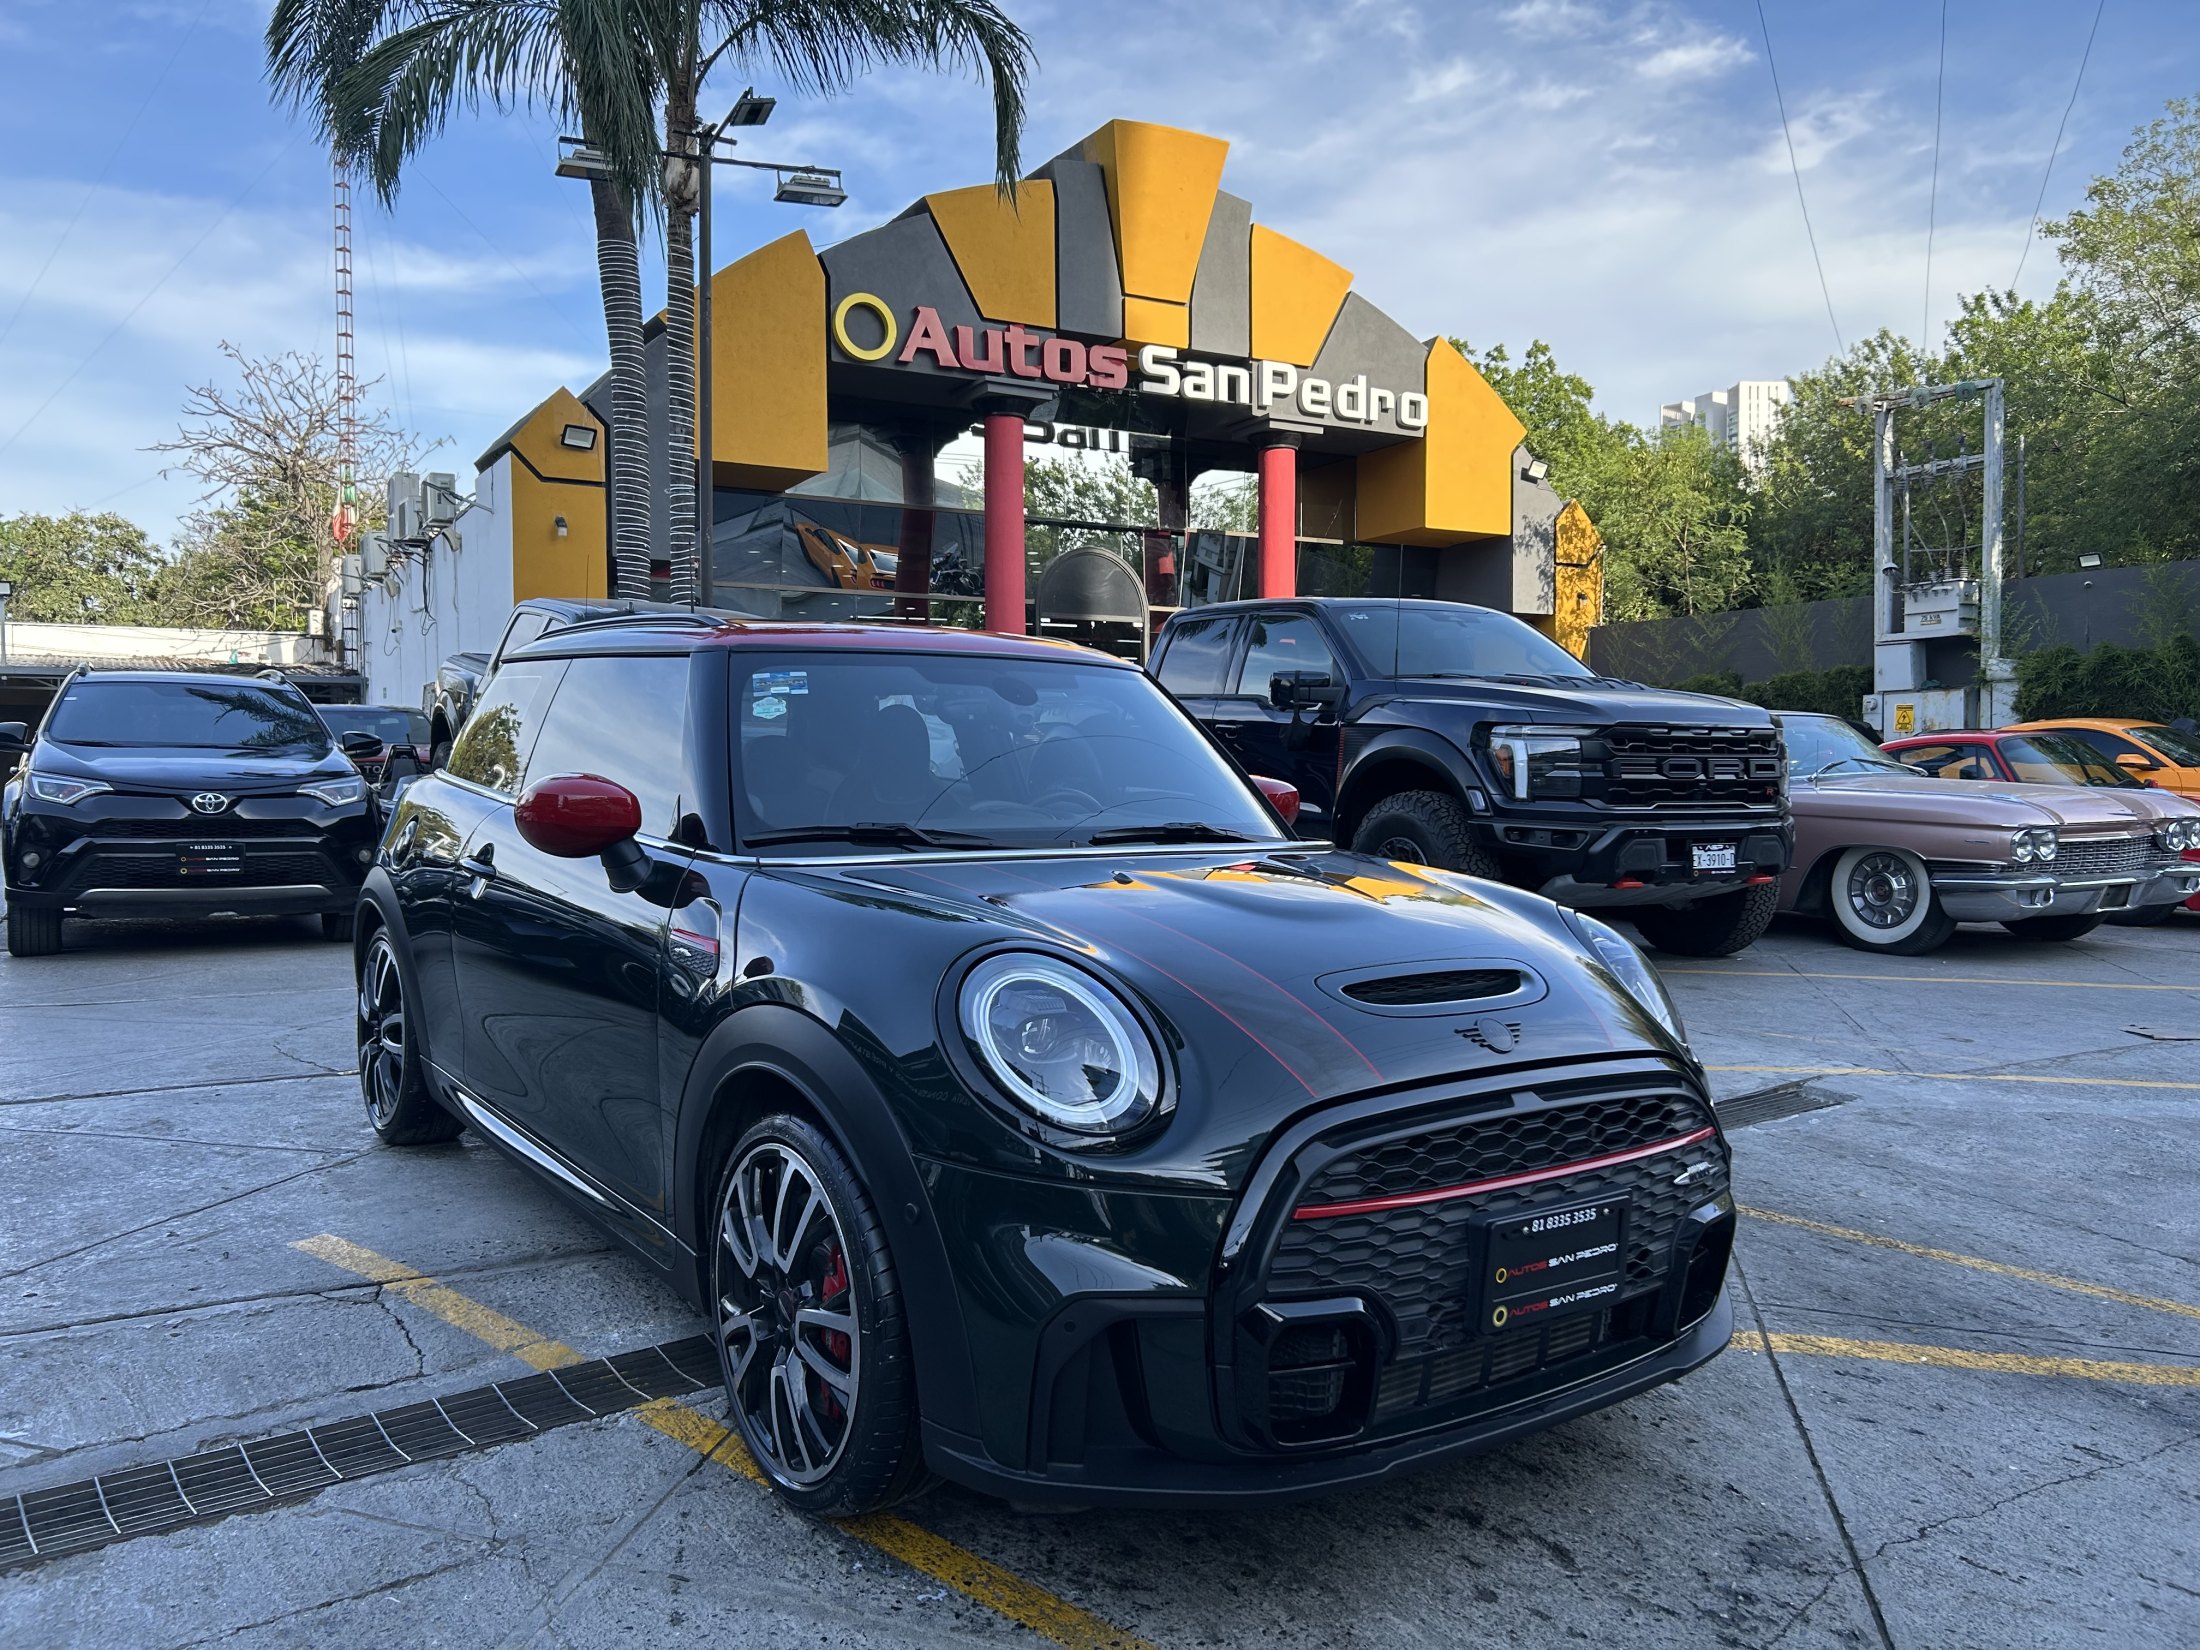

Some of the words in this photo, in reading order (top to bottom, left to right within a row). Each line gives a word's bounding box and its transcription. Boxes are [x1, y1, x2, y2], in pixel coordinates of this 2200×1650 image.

[899, 306, 1128, 390] Autos
[1607, 757, 1782, 780] FORD
[1531, 1219, 1545, 1233] 81
[1546, 1213, 1571, 1229] 8335
[1572, 1208, 1597, 1224] 3535
[1507, 1261, 1547, 1277] AUTOS
[1548, 1253, 1575, 1267] SAN
[1575, 1243, 1617, 1261] PEDRO
[1508, 1301, 1549, 1318] AUTOS
[1549, 1294, 1575, 1307] SAN
[1575, 1284, 1617, 1301] PEDRO
